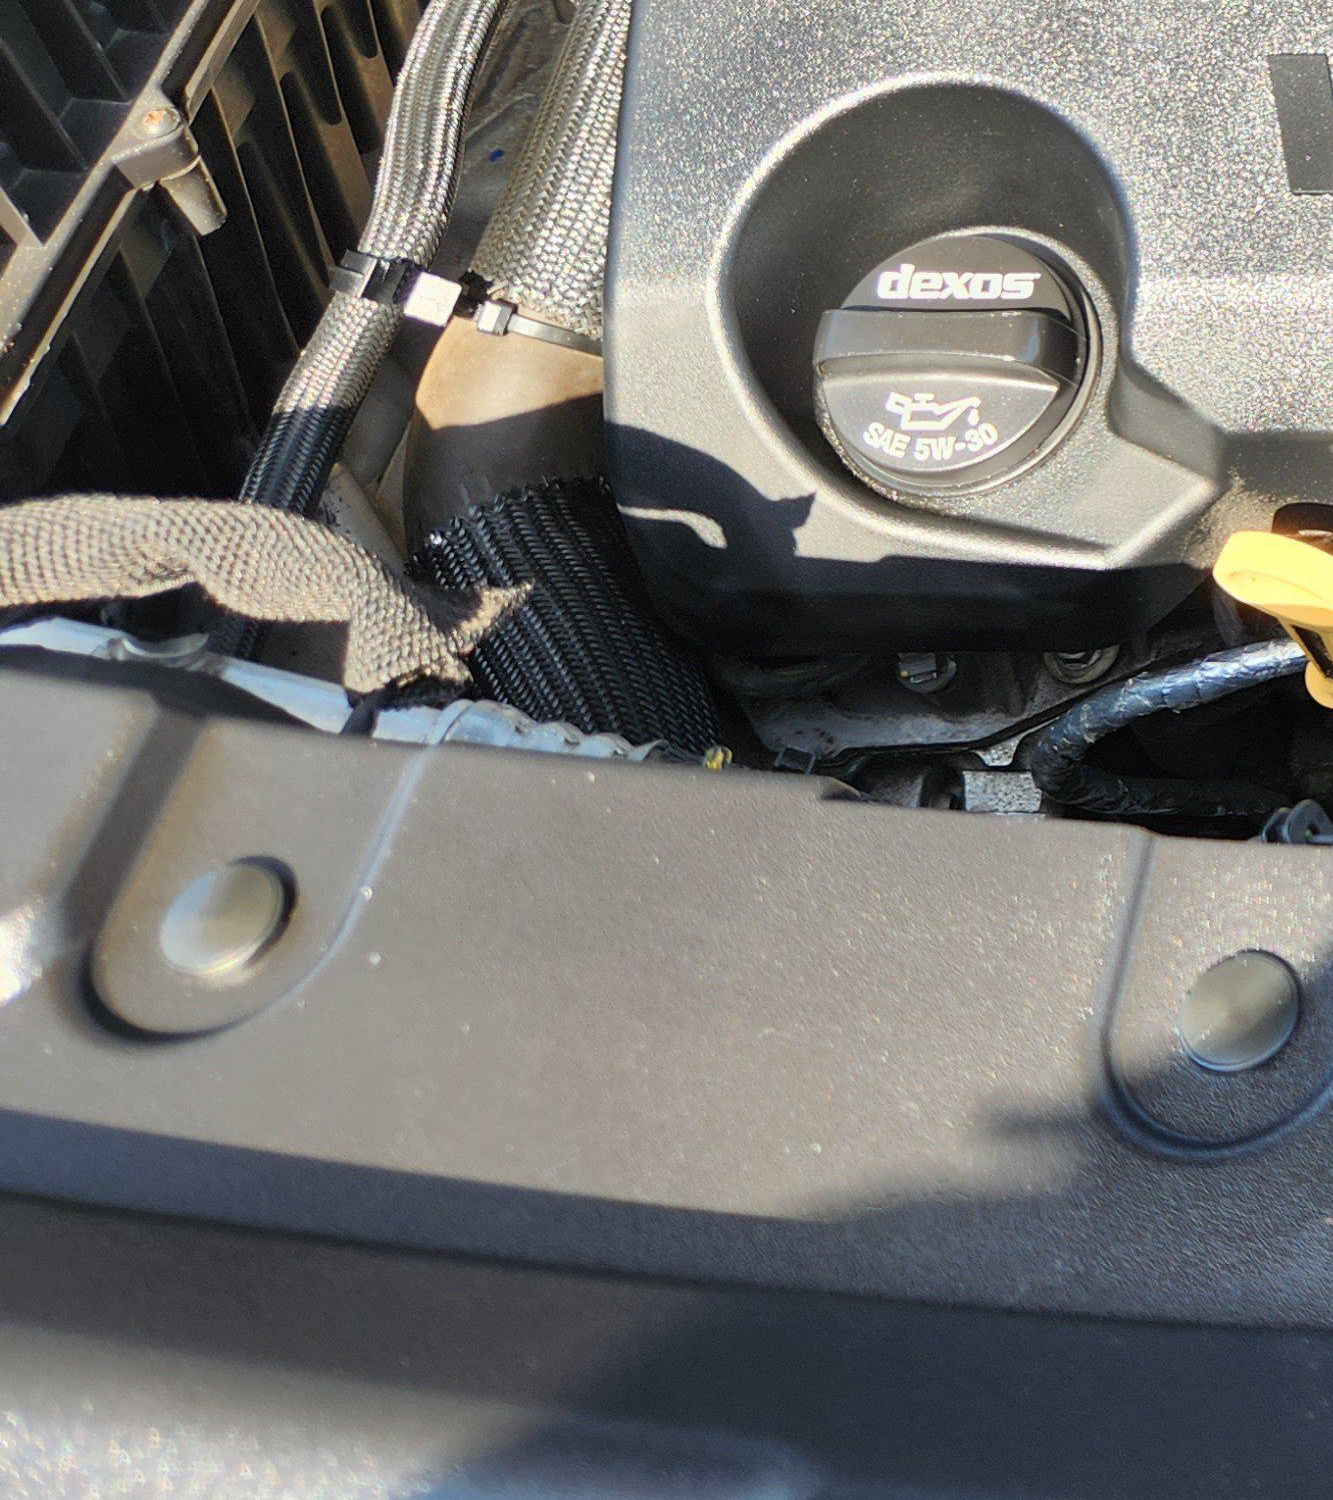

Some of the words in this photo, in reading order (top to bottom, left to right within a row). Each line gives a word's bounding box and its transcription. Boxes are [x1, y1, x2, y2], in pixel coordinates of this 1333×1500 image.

[876, 263, 1041, 301] dexos
[863, 421, 909, 458] SAE
[914, 422, 999, 462] 5W-30
